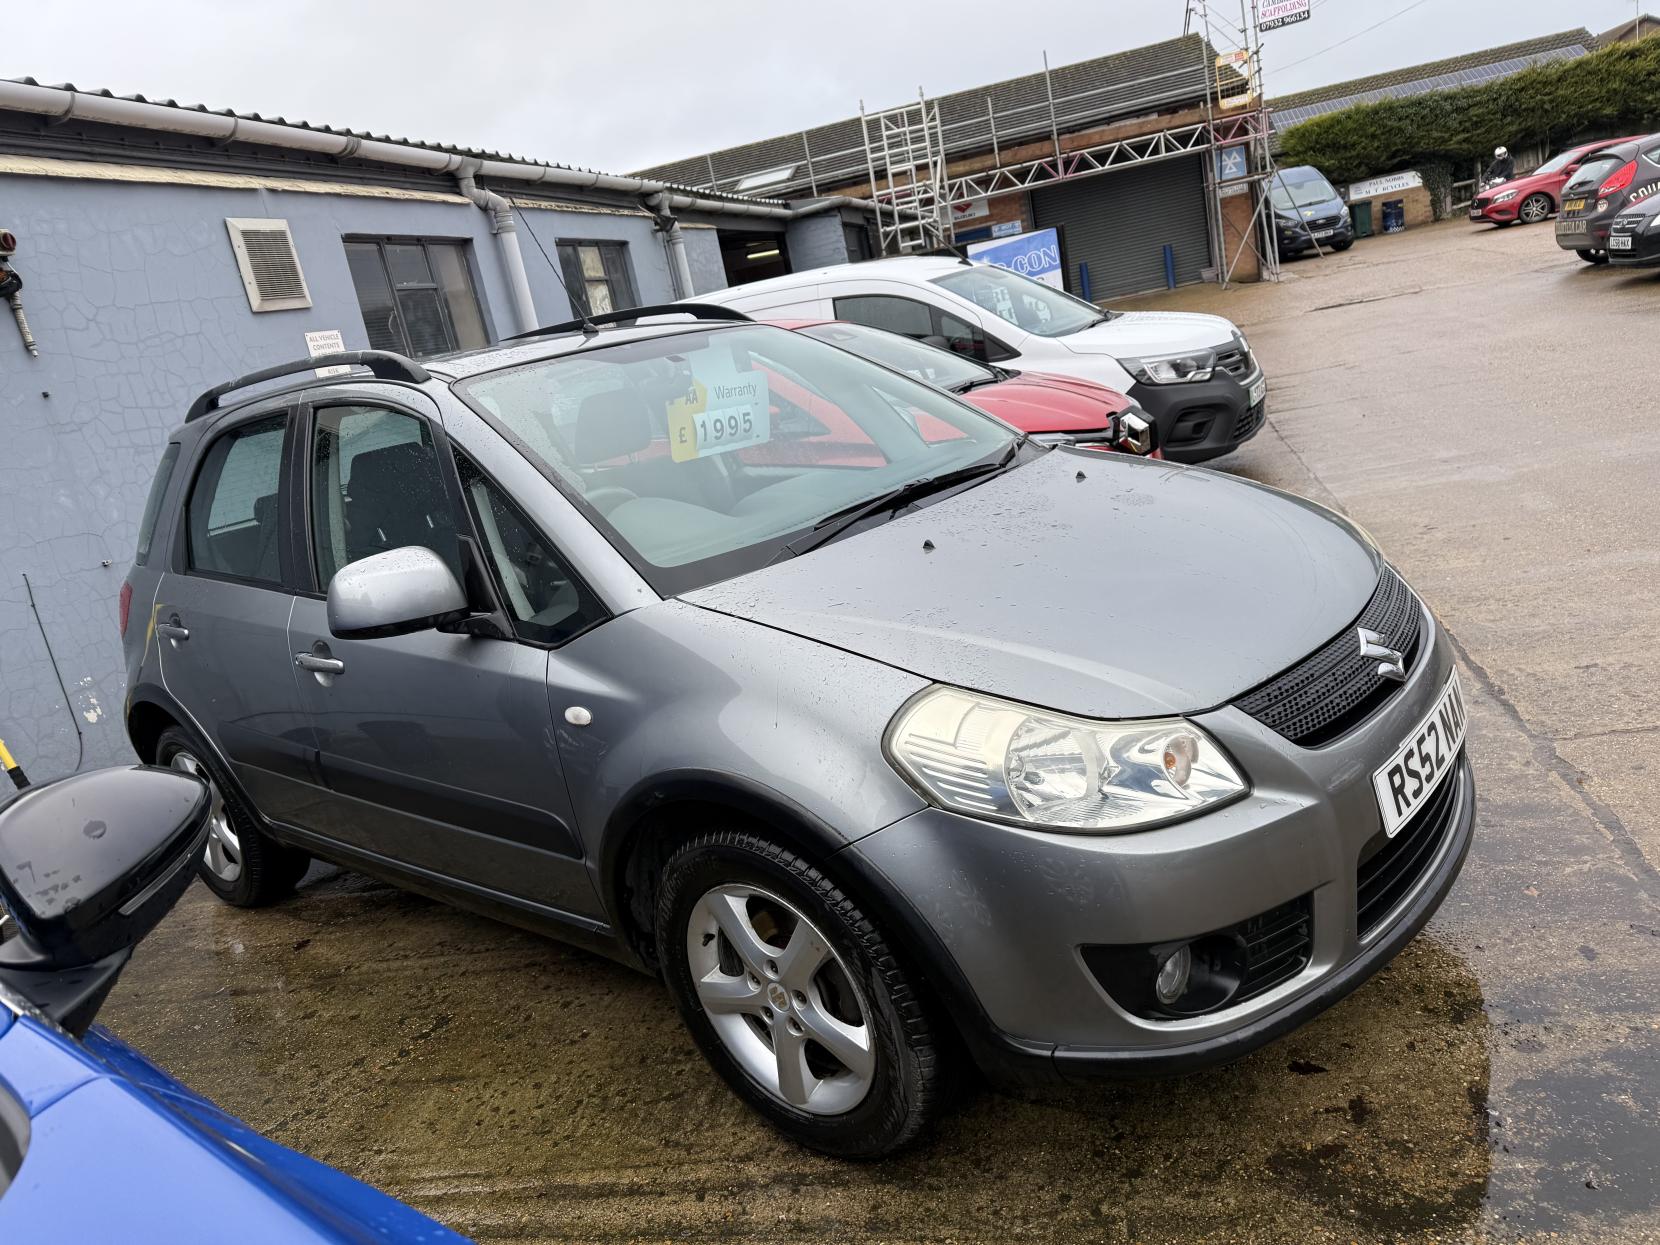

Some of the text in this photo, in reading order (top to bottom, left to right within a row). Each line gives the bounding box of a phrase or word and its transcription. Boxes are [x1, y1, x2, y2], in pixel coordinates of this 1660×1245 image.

[1261, 0, 1307, 17] SCAFFOLDING
[1261, 11, 1308, 30] 07932 966134
[1575, 220, 1587, 233] CAR
[312, 342, 340, 351] CONTENTS
[685, 383, 757, 405] AA Warranty
[700, 412, 753, 441] 1995
[1387, 720, 1446, 818] RS52
